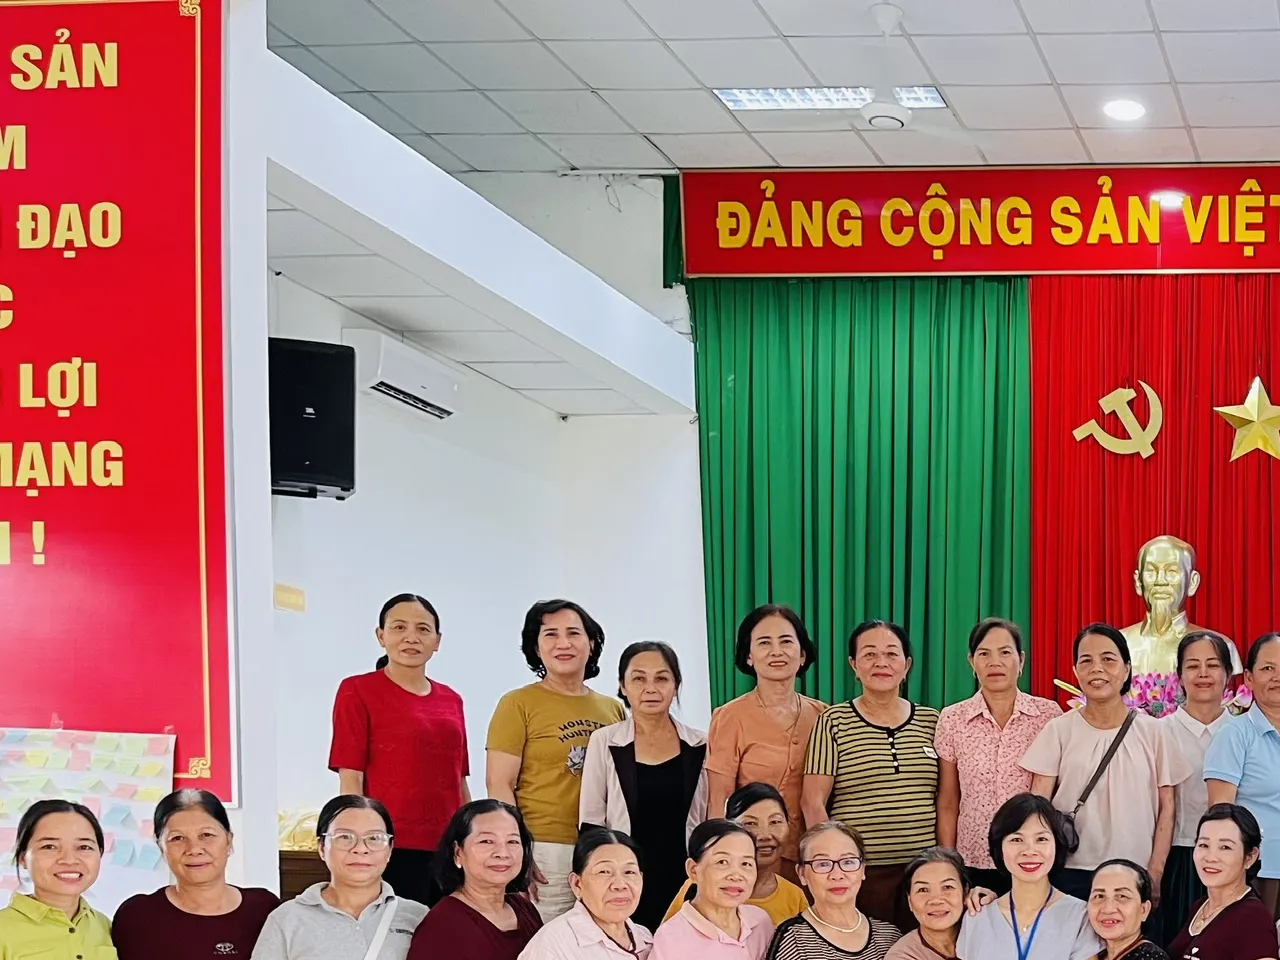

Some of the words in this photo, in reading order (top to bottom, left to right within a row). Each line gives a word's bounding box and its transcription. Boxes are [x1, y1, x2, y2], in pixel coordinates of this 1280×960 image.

[11, 28, 118, 90] SẢN
[16, 201, 121, 258] ĐẠO
[716, 179, 862, 248] ĐẢNG
[880, 182, 1032, 260] CỘNG
[1050, 175, 1161, 246] SẢN
[19, 356, 97, 417] LỢI
